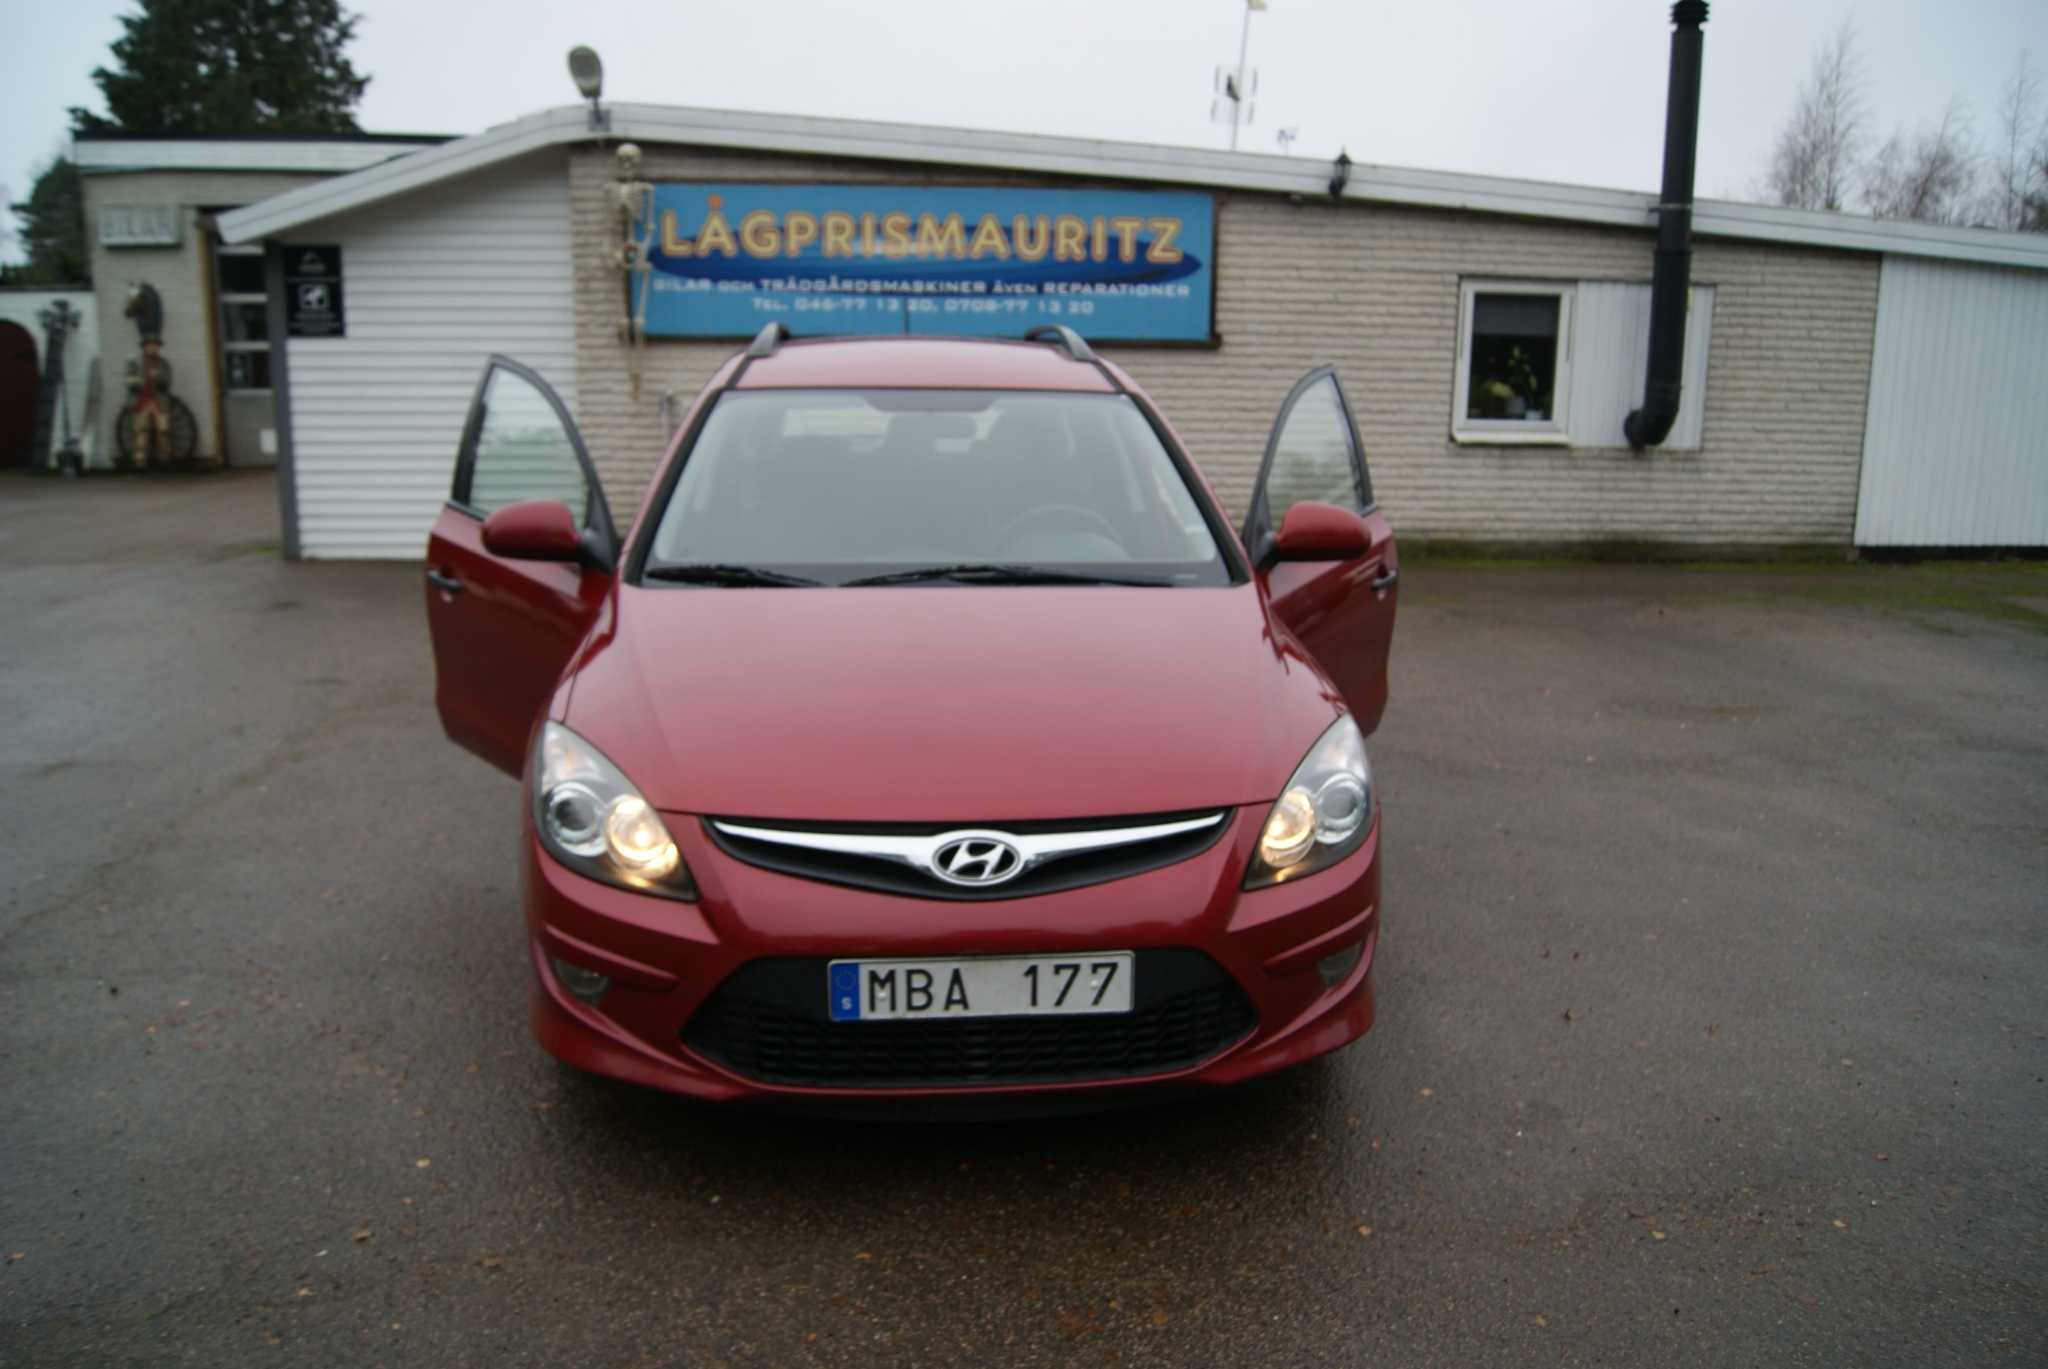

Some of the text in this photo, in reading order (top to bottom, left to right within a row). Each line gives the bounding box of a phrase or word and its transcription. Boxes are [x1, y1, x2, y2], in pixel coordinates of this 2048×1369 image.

[661, 193, 1184, 264] LÅGPRISMAURITZ
[653, 278, 712, 292] BILAR
[760, 275, 988, 294] TRÅDGÅRDSMASKINER
[992, 279, 1038, 294] ÄVEN
[1043, 281, 1191, 297] REPARATIONER
[794, 297, 868, 311] 046-77
[876, 297, 900, 311] 13
[1038, 299, 1062, 313] 13
[1069, 300, 1096, 314] 20
[867, 961, 1119, 1013] MBA 177
[840, 996, 853, 1010] S
